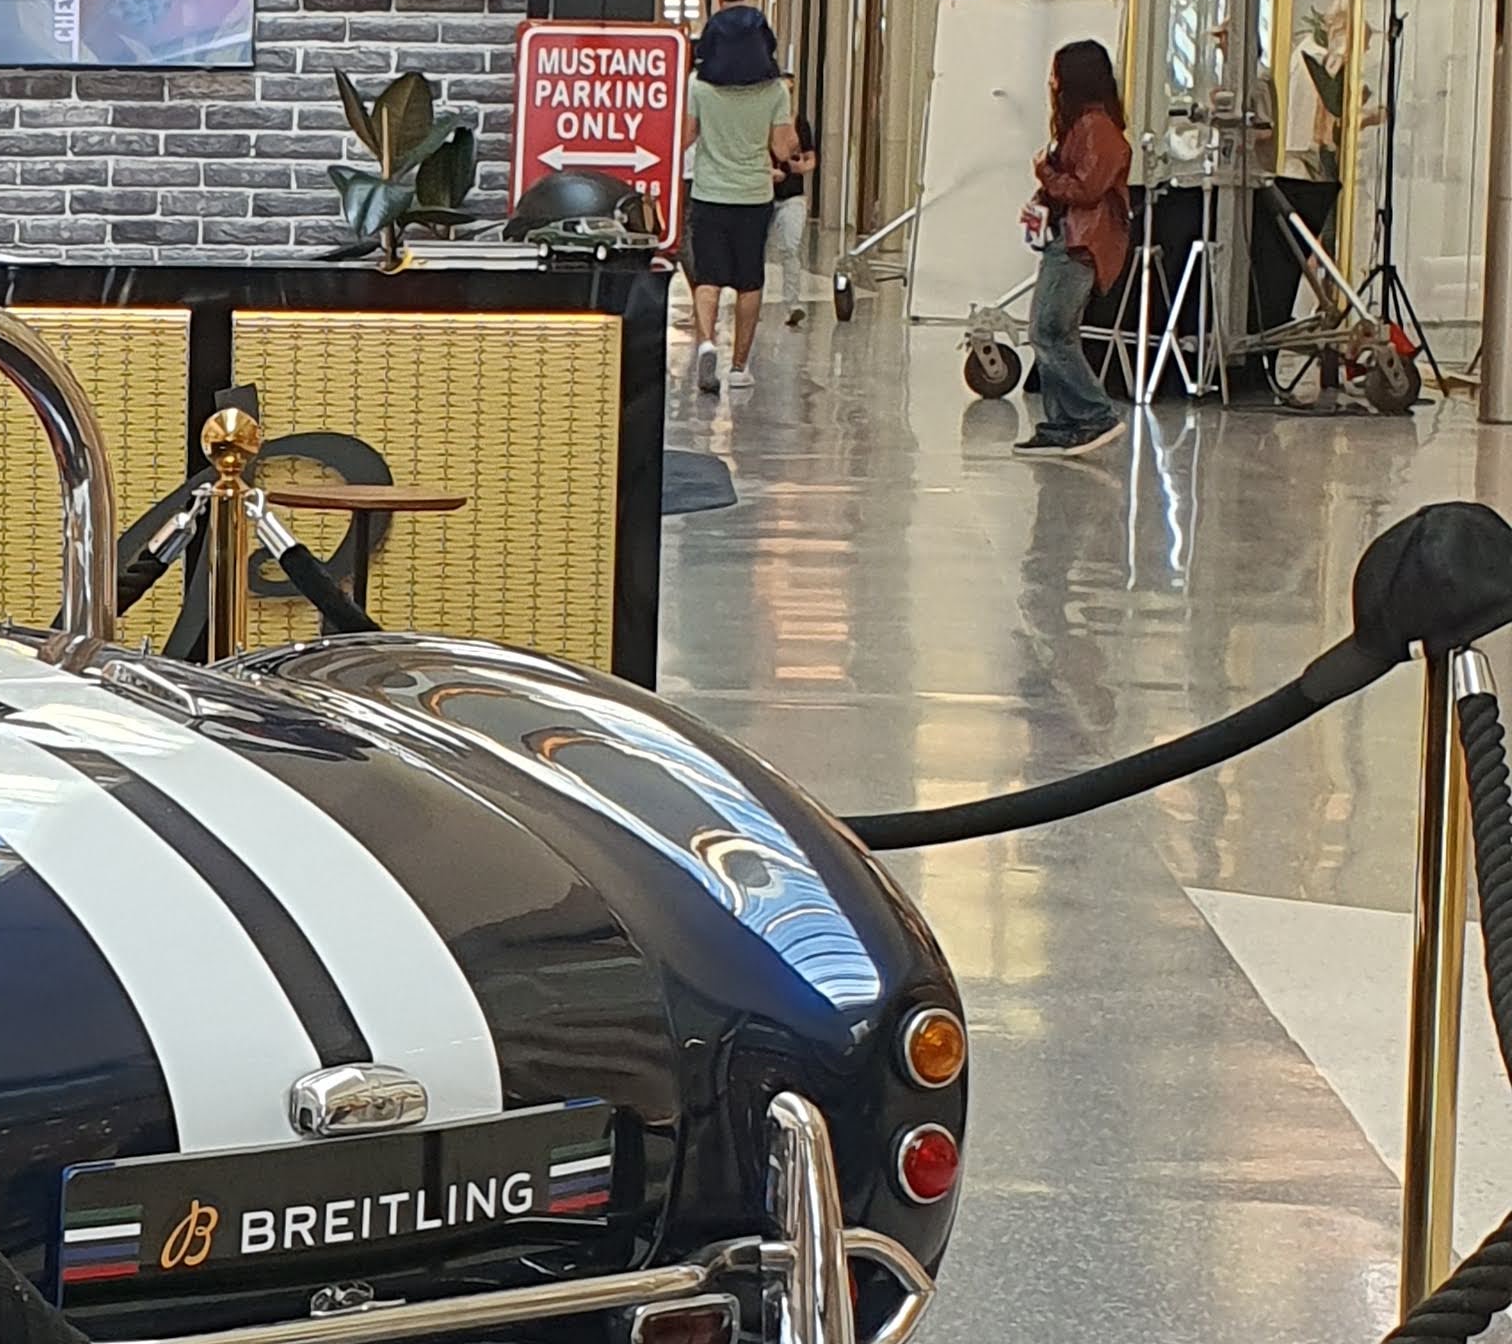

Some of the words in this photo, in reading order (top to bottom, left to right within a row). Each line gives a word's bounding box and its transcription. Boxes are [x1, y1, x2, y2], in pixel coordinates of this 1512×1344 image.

[537, 47, 666, 76] MUSTANG
[535, 80, 668, 109] PARKING
[556, 112, 643, 141] ONLY
[240, 1171, 533, 1255] BREITLING
